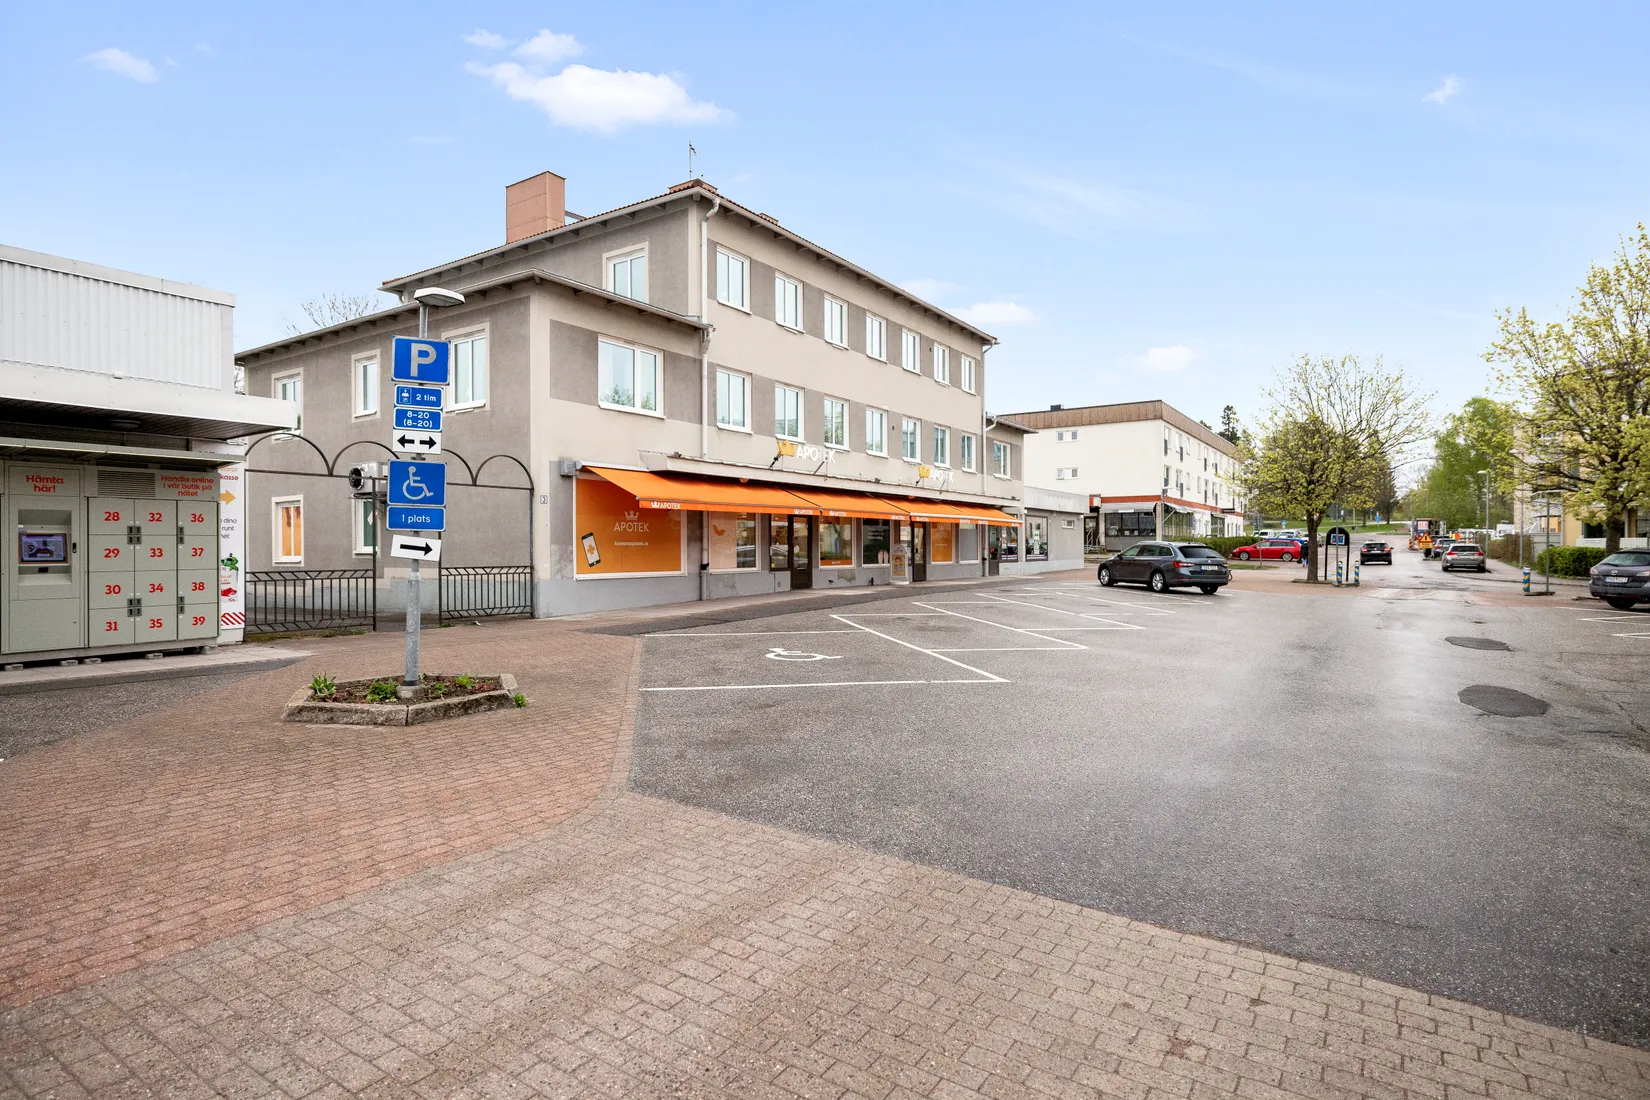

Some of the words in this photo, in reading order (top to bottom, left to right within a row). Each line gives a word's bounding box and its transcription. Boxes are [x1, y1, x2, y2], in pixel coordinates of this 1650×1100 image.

[410, 342, 437, 377] P
[424, 394, 436, 402] tim
[404, 419, 432, 429] (8-20)
[796, 445, 836, 464] APOTEK
[26, 474, 64, 484] Hämta
[160, 475, 190, 483] Handla
[930, 469, 954, 482] APOTEK
[33, 484, 56, 493] här!
[202, 484, 212, 492] på
[104, 511, 120, 522] 28
[148, 512, 162, 522] 32
[190, 512, 204, 523] 36
[402, 514, 405, 523] 1
[408, 514, 431, 525] plats
[614, 522, 650, 532] APOTEK
[104, 548, 120, 559] 29
[150, 548, 164, 558] 33
[191, 547, 204, 557] 37
[105, 584, 121, 595] 30
[149, 583, 164, 594] 34
[191, 582, 205, 592] 38
[149, 618, 163, 629] 35
[192, 616, 206, 626] 39
[105, 622, 118, 632] 31
